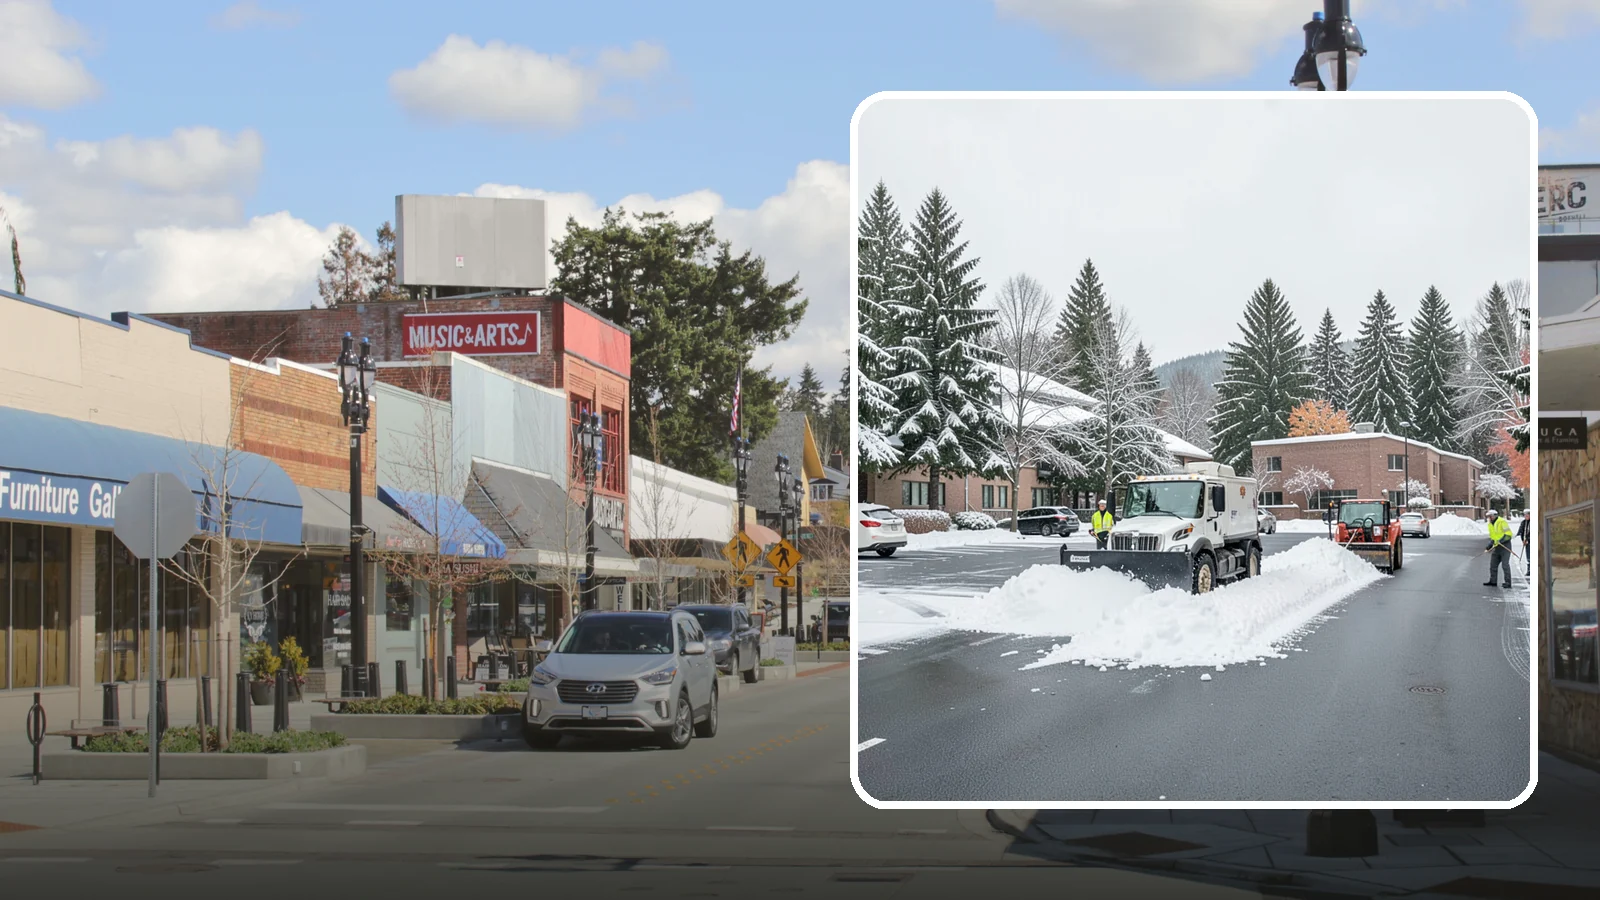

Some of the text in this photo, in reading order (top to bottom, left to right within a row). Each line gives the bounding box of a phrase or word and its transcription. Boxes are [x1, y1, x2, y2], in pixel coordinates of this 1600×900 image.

[1540, 427, 1578, 437] UGA
[0, 471, 121, 519] Furniture Gal
[453, 563, 479, 574] SUSHI
